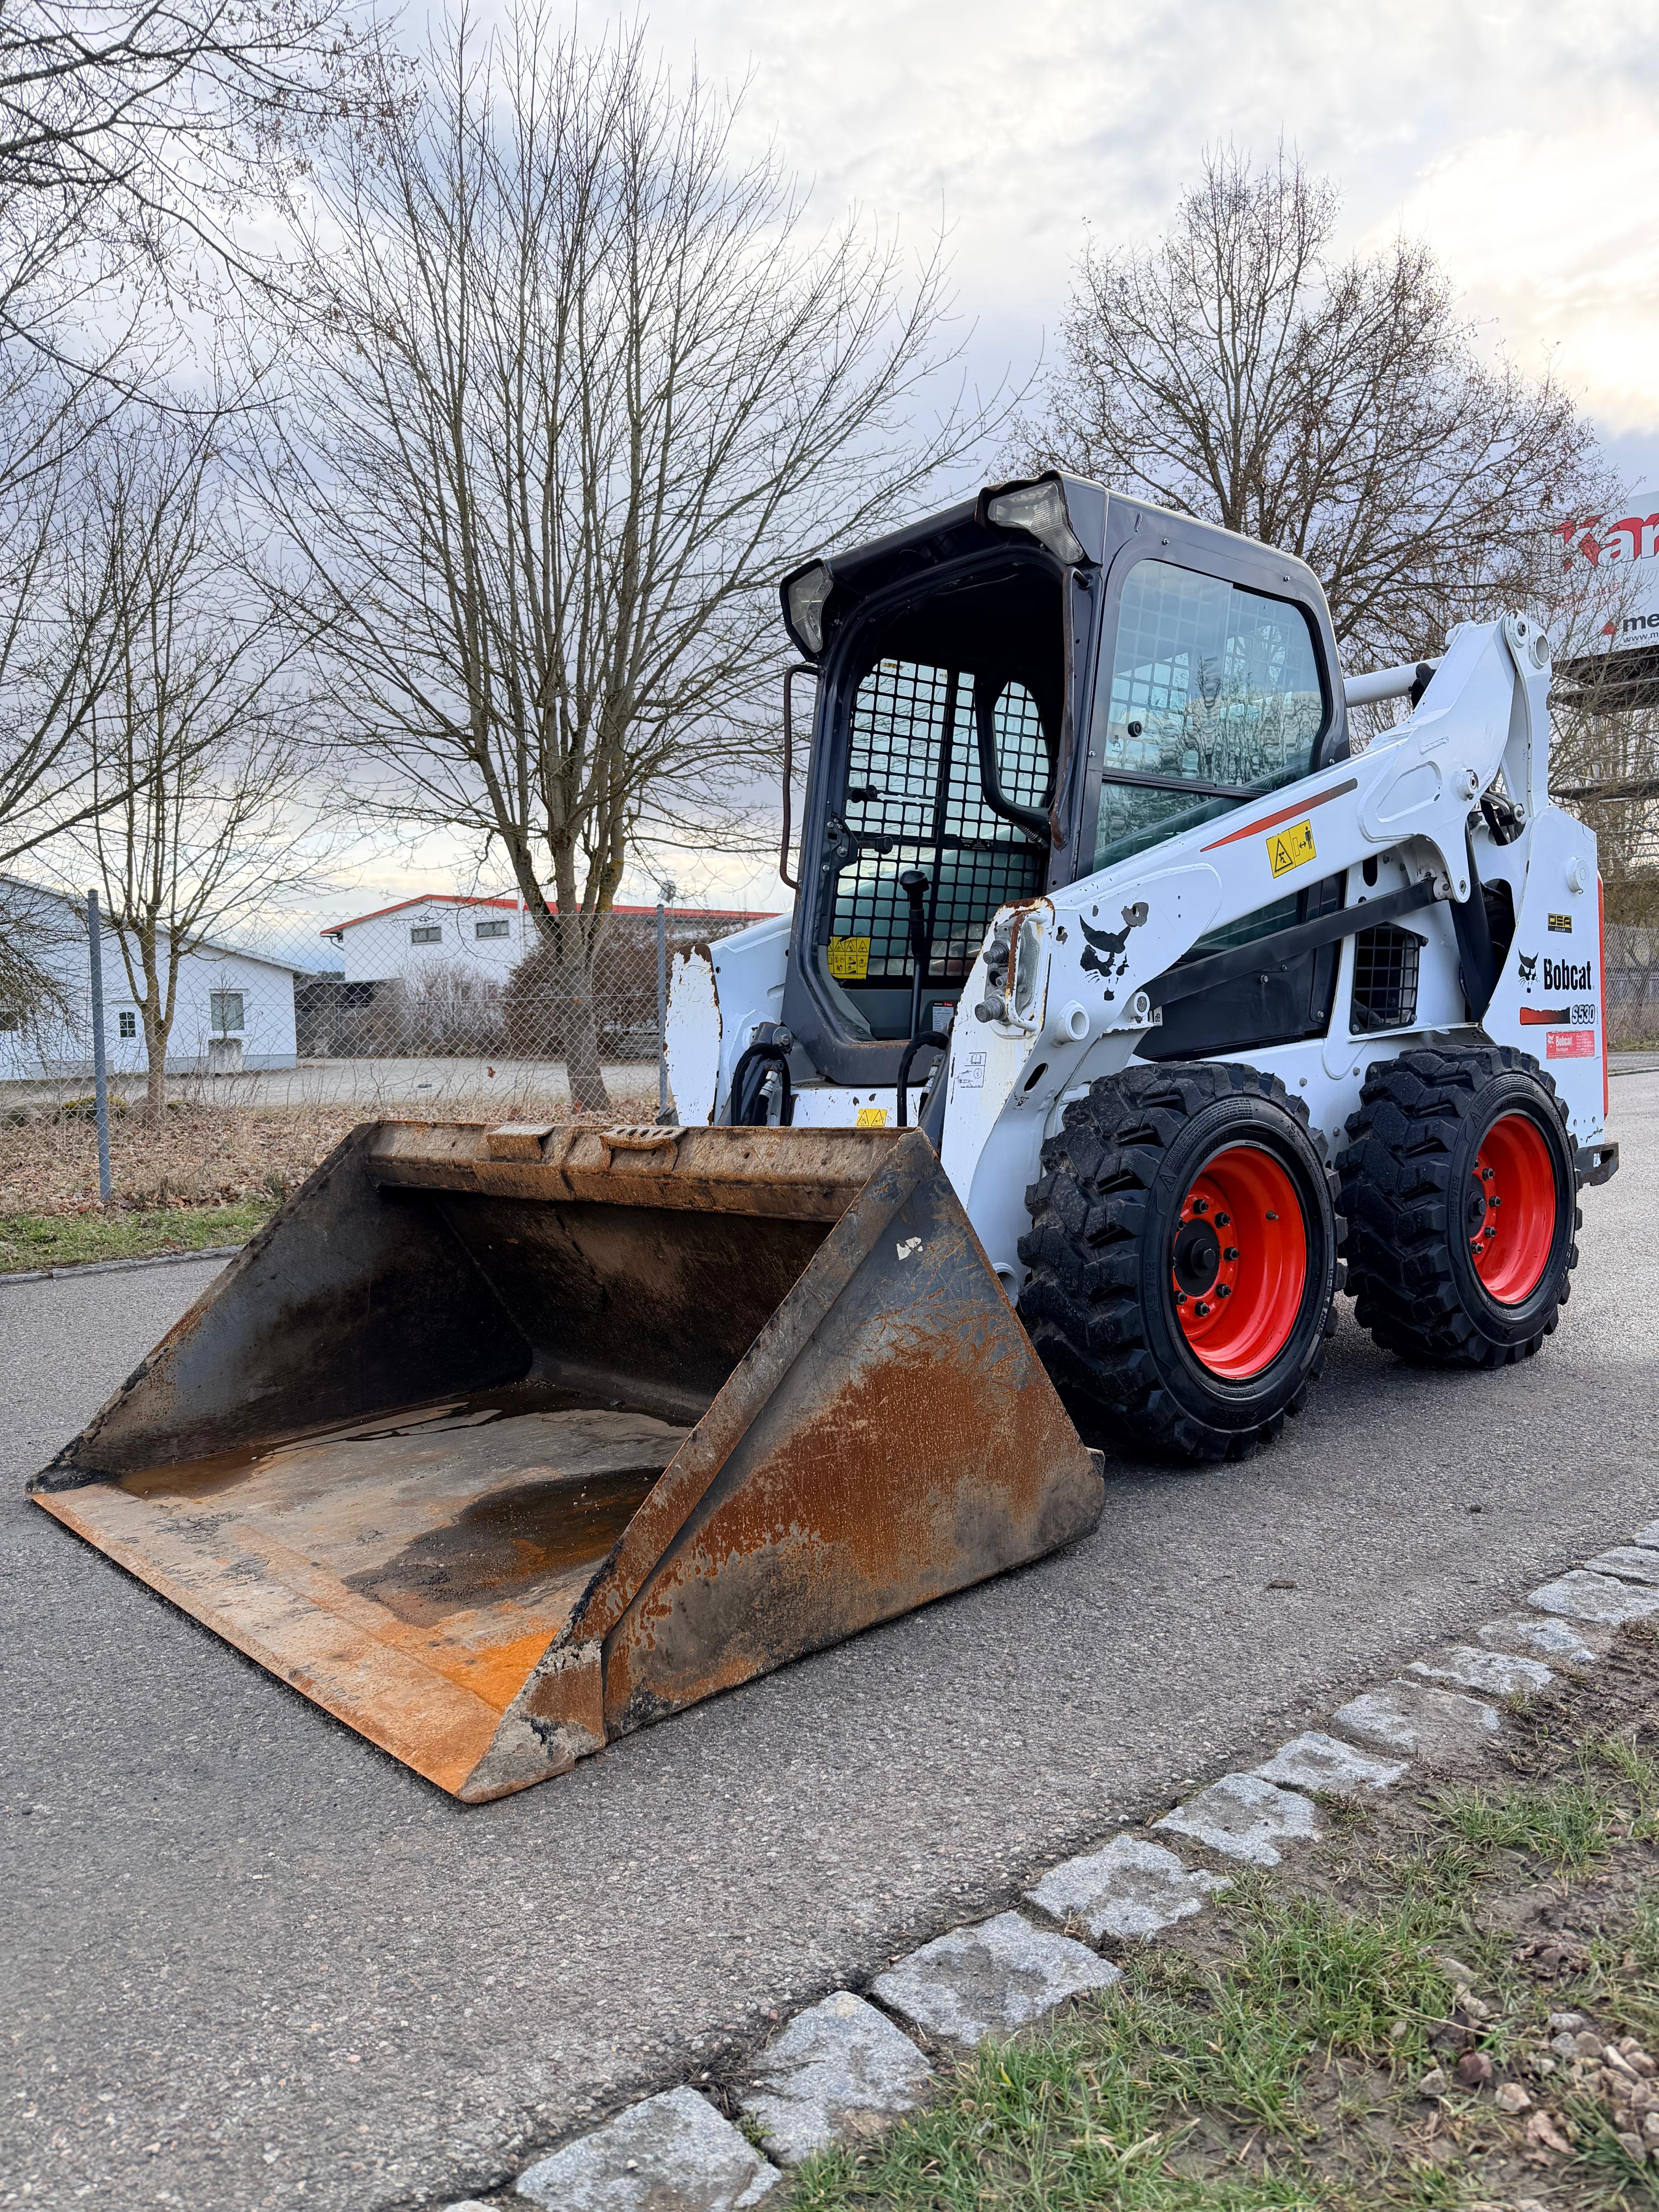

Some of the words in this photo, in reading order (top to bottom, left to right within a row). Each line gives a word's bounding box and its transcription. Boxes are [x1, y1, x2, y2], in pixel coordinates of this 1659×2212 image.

[1544, 958, 1592, 990] Bobcat
[1571, 1004, 1595, 1025] S530
[1556, 1036, 1572, 1046] Bobcat
